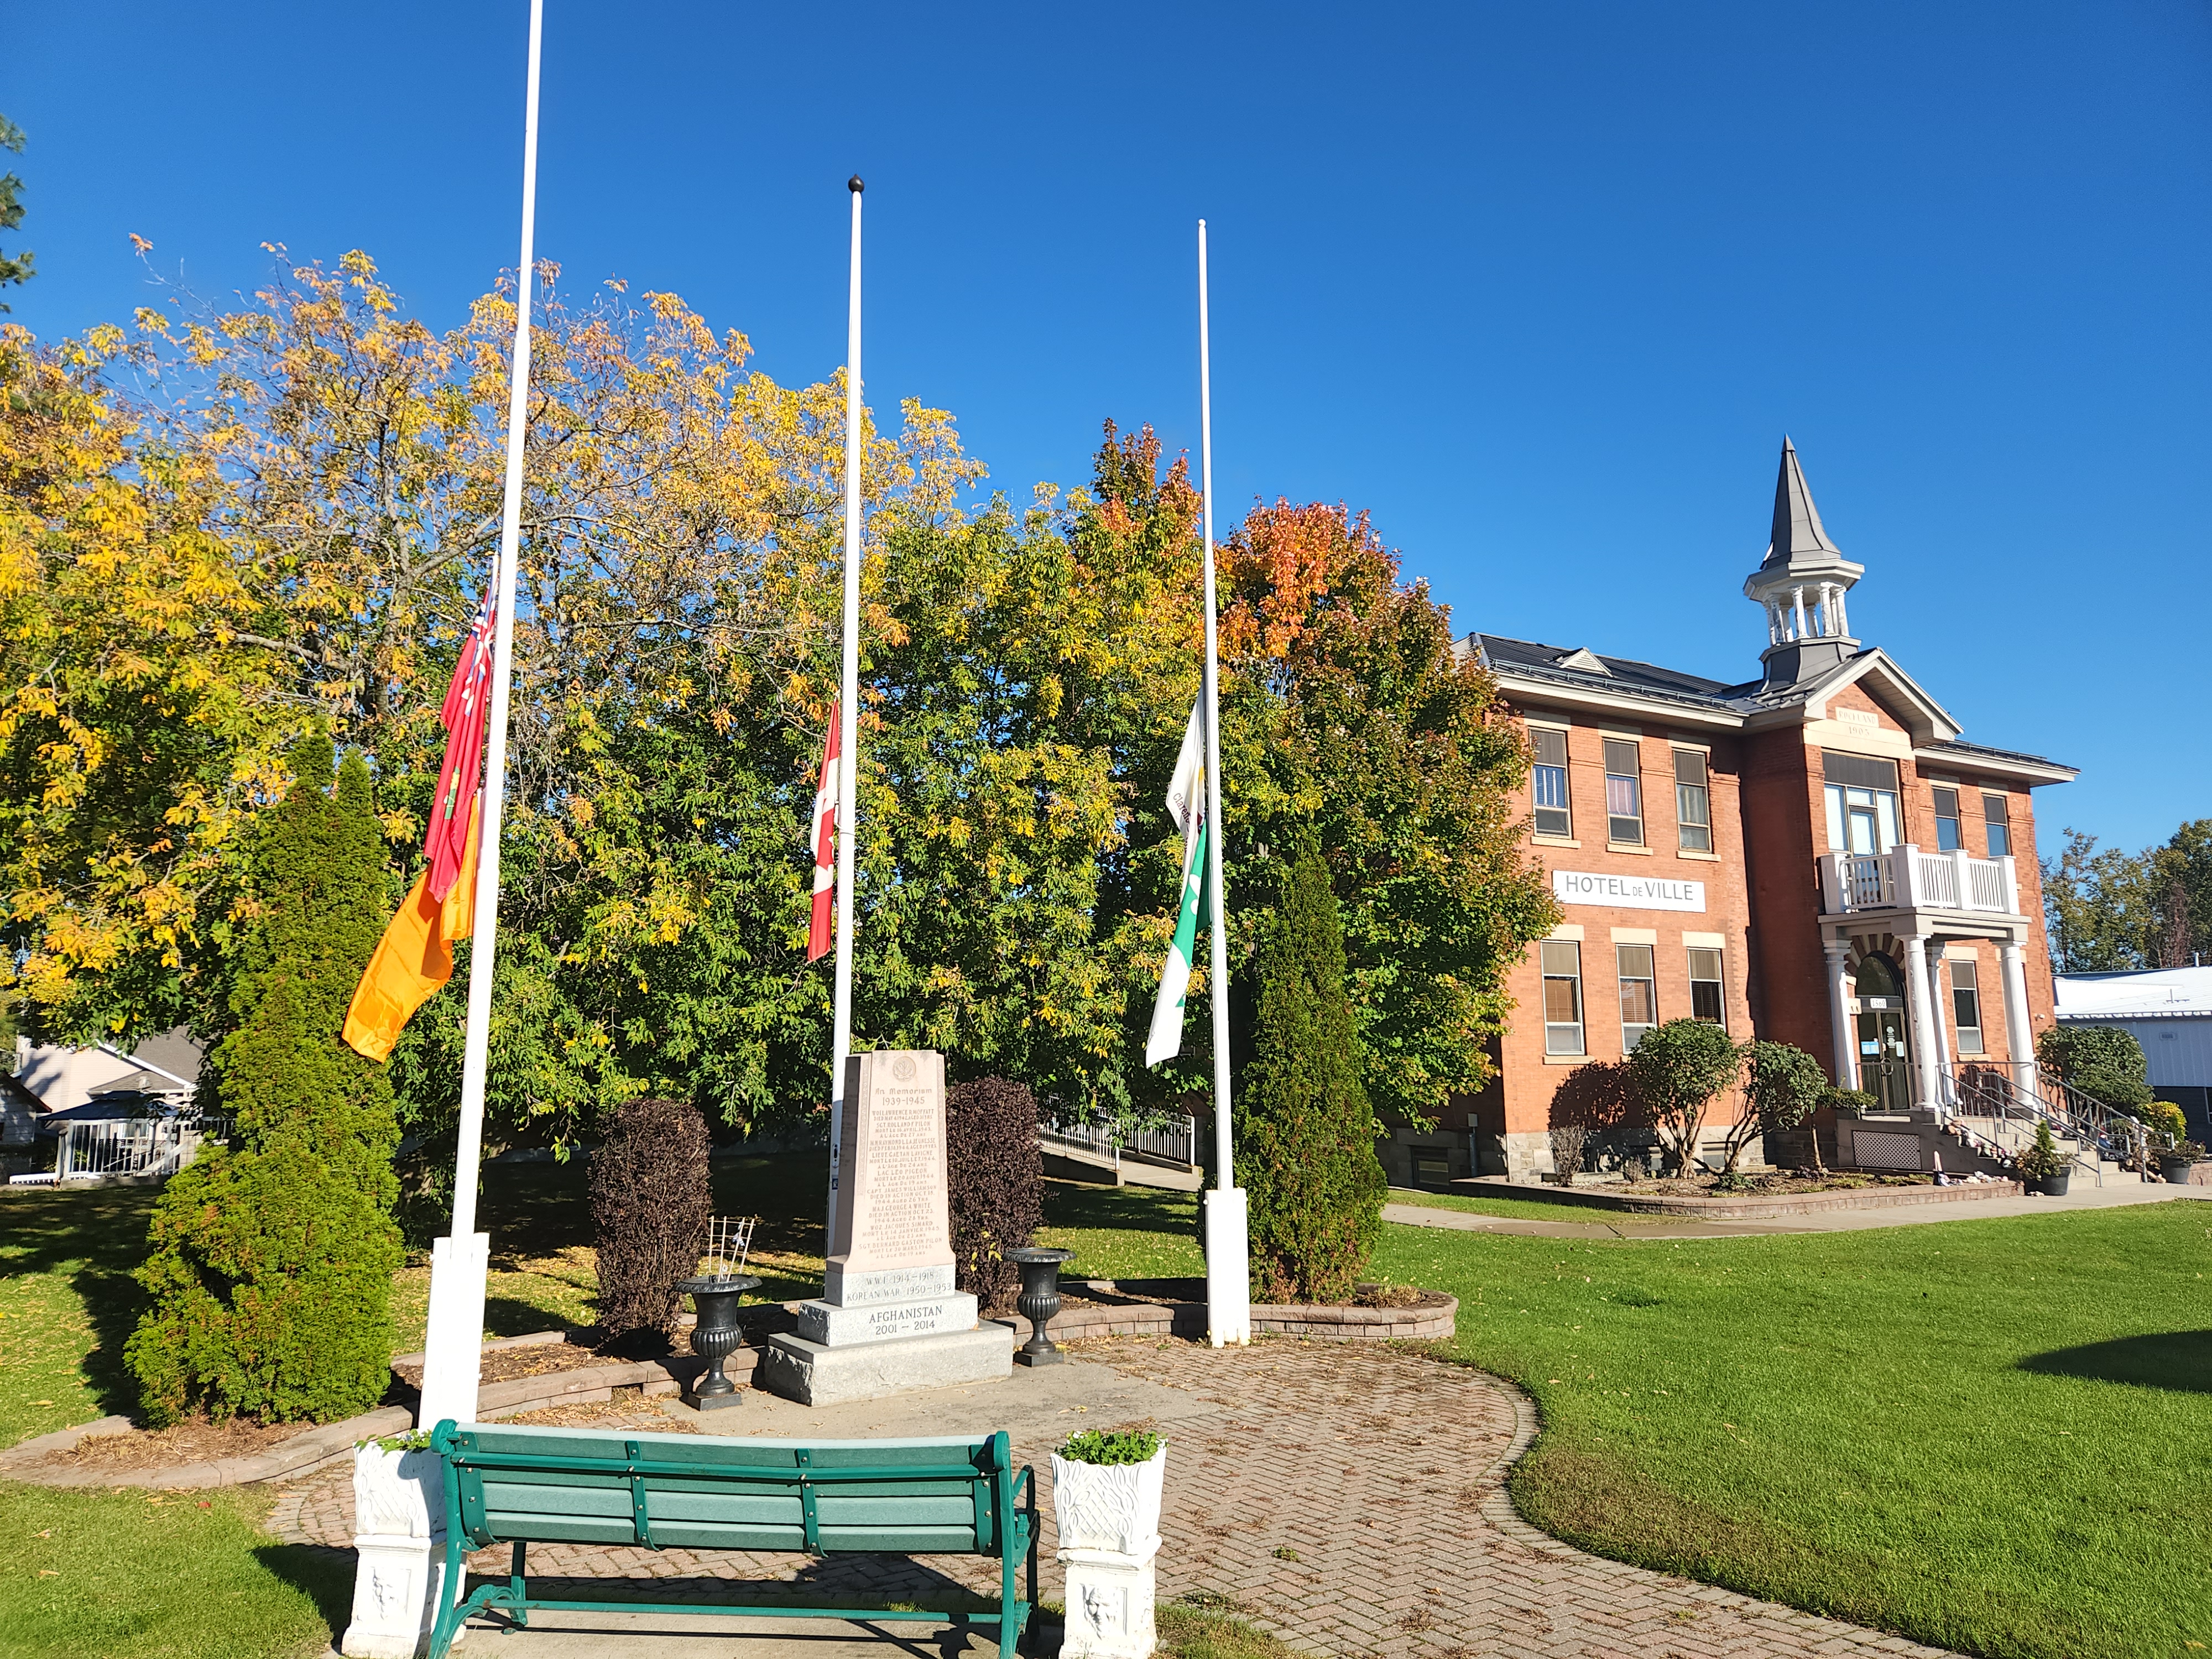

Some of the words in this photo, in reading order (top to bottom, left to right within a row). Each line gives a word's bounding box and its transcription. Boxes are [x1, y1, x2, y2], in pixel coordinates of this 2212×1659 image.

[1849, 726, 1869, 737] 1905
[1566, 875, 1630, 896] HOTEL
[1632, 886, 1643, 896] DE
[1645, 881, 1693, 900] VILLE
[883, 1096, 925, 1106] 1939-1945
[847, 1290, 880, 1301] KOREAN
[884, 1288, 900, 1297] WAR
[869, 1305, 942, 1324] AFGHANISTAN
[876, 1324, 897, 1335] 2001
[914, 1320, 935, 1331] 2014
